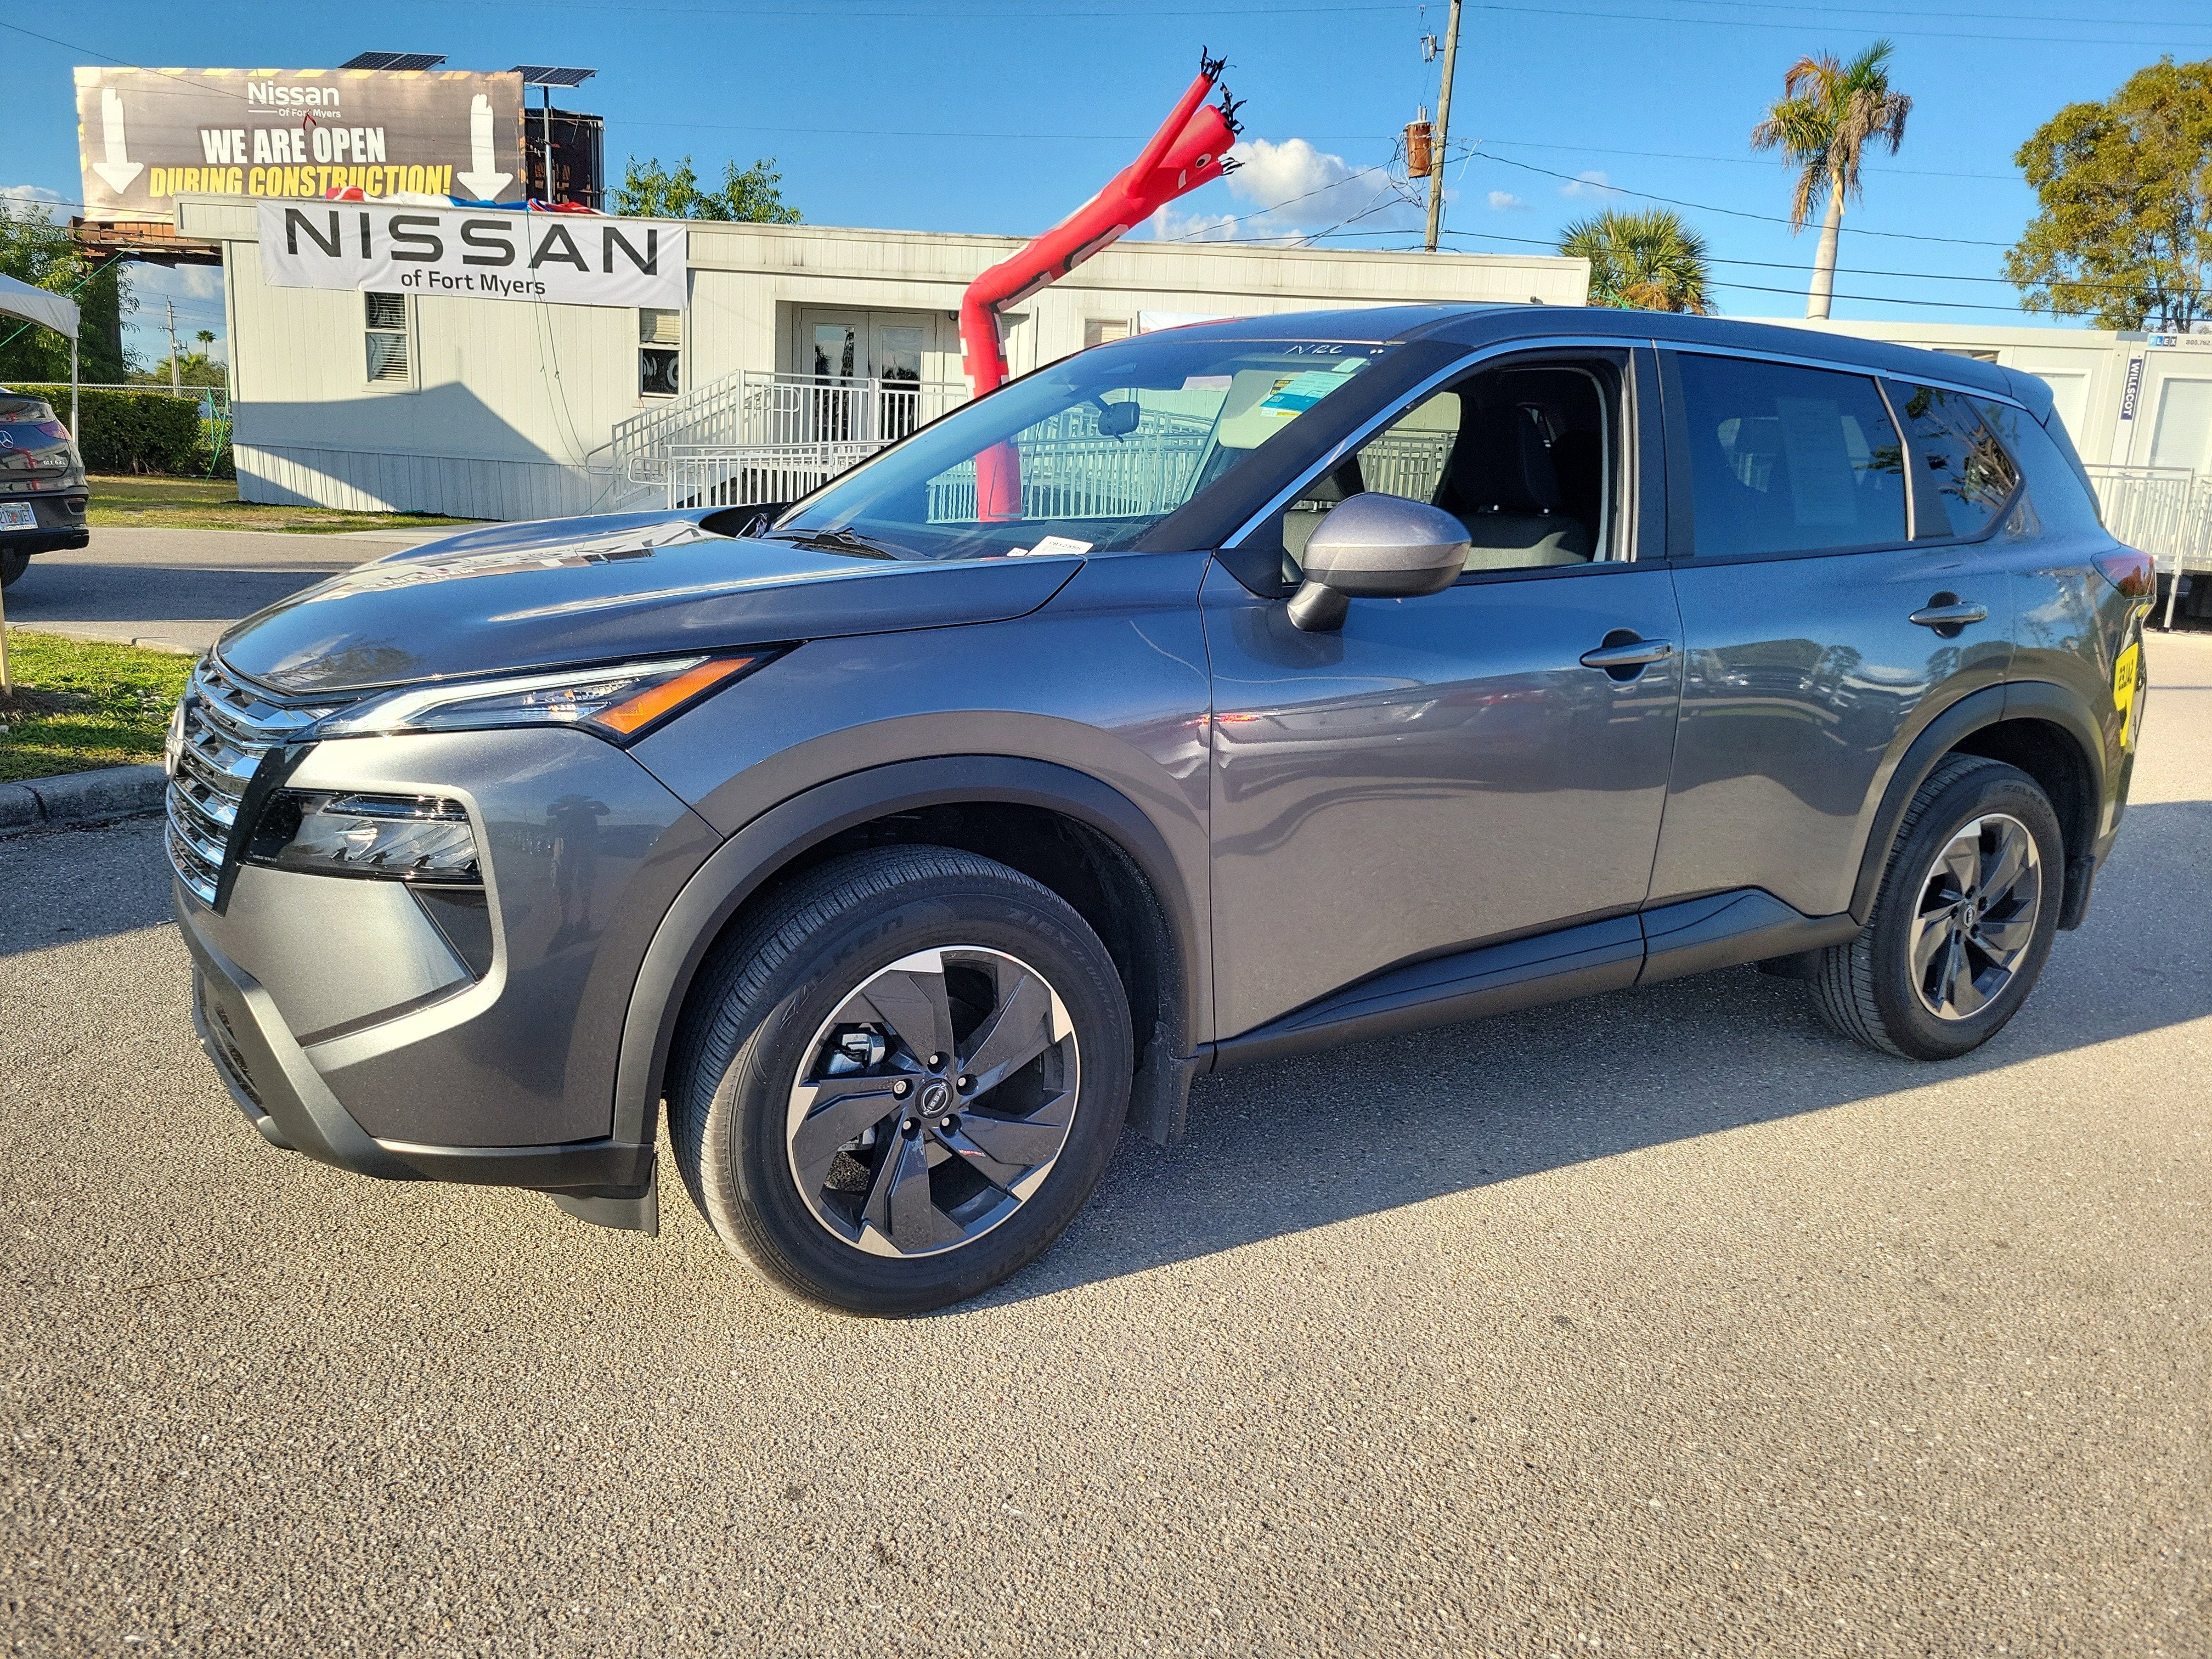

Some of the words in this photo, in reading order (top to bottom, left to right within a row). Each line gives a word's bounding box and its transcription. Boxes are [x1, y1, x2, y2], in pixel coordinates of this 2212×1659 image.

[247, 81, 339, 106] Nissan
[278, 108, 290, 117] Of
[313, 109, 341, 119] Myers
[200, 128, 248, 164] WE
[253, 127, 307, 163] ARE
[312, 126, 386, 163] OPEN
[150, 167, 243, 198] DURING
[249, 165, 452, 197] CONSTRUCTION!
[285, 208, 658, 276] NISSAN
[400, 269, 423, 289] of
[428, 270, 475, 289] Fort
[480, 274, 546, 297] Myers
[2149, 337, 2176, 346] FLEX
[2123, 362, 2140, 416] WILLSCOT
[923, 1081, 946, 1116] NISSAN
